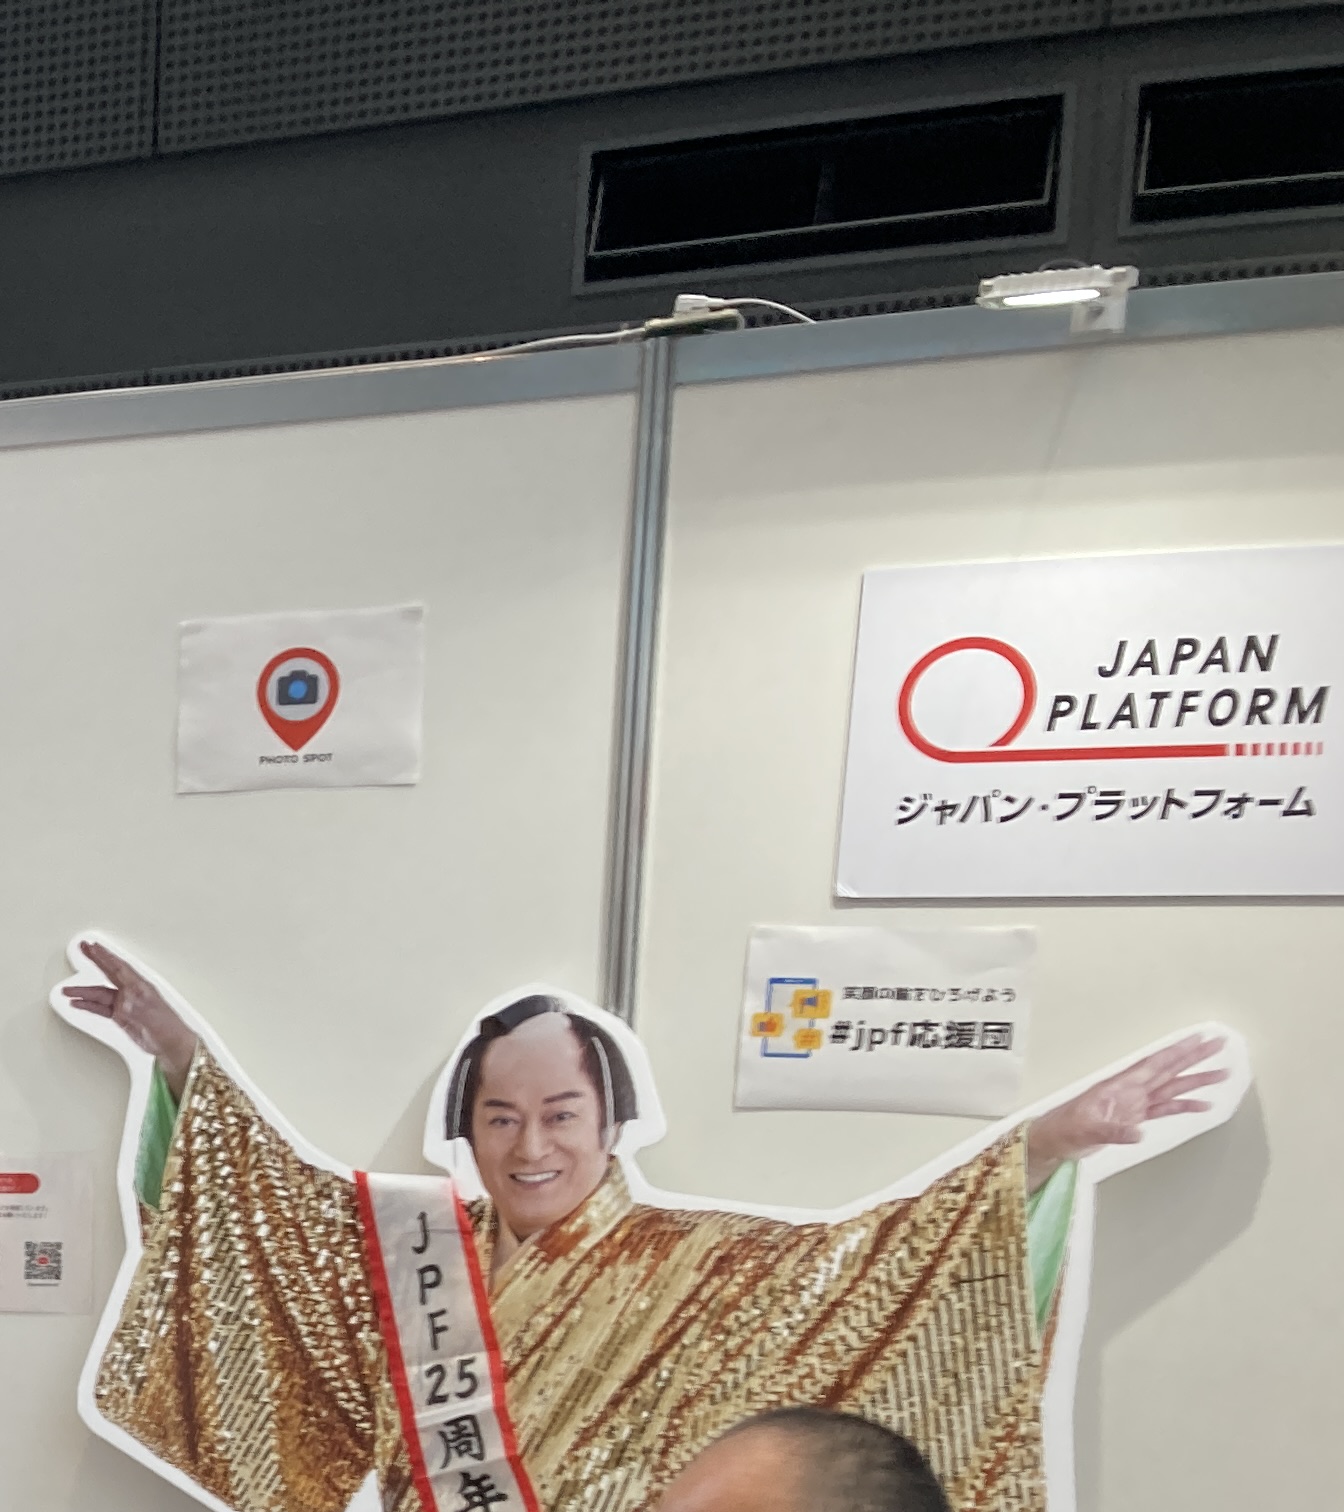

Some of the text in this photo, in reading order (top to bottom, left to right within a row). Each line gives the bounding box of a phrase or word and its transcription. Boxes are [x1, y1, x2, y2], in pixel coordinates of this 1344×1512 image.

[1098, 633, 1279, 679] JAPAN
[1047, 685, 1330, 733] PLATFORM
[259, 753, 332, 766] PHOTO SPOT
[895, 786, 1315, 825] ジャパン・プラットフォーム
[829, 1019, 1014, 1052] #jpf応援団
